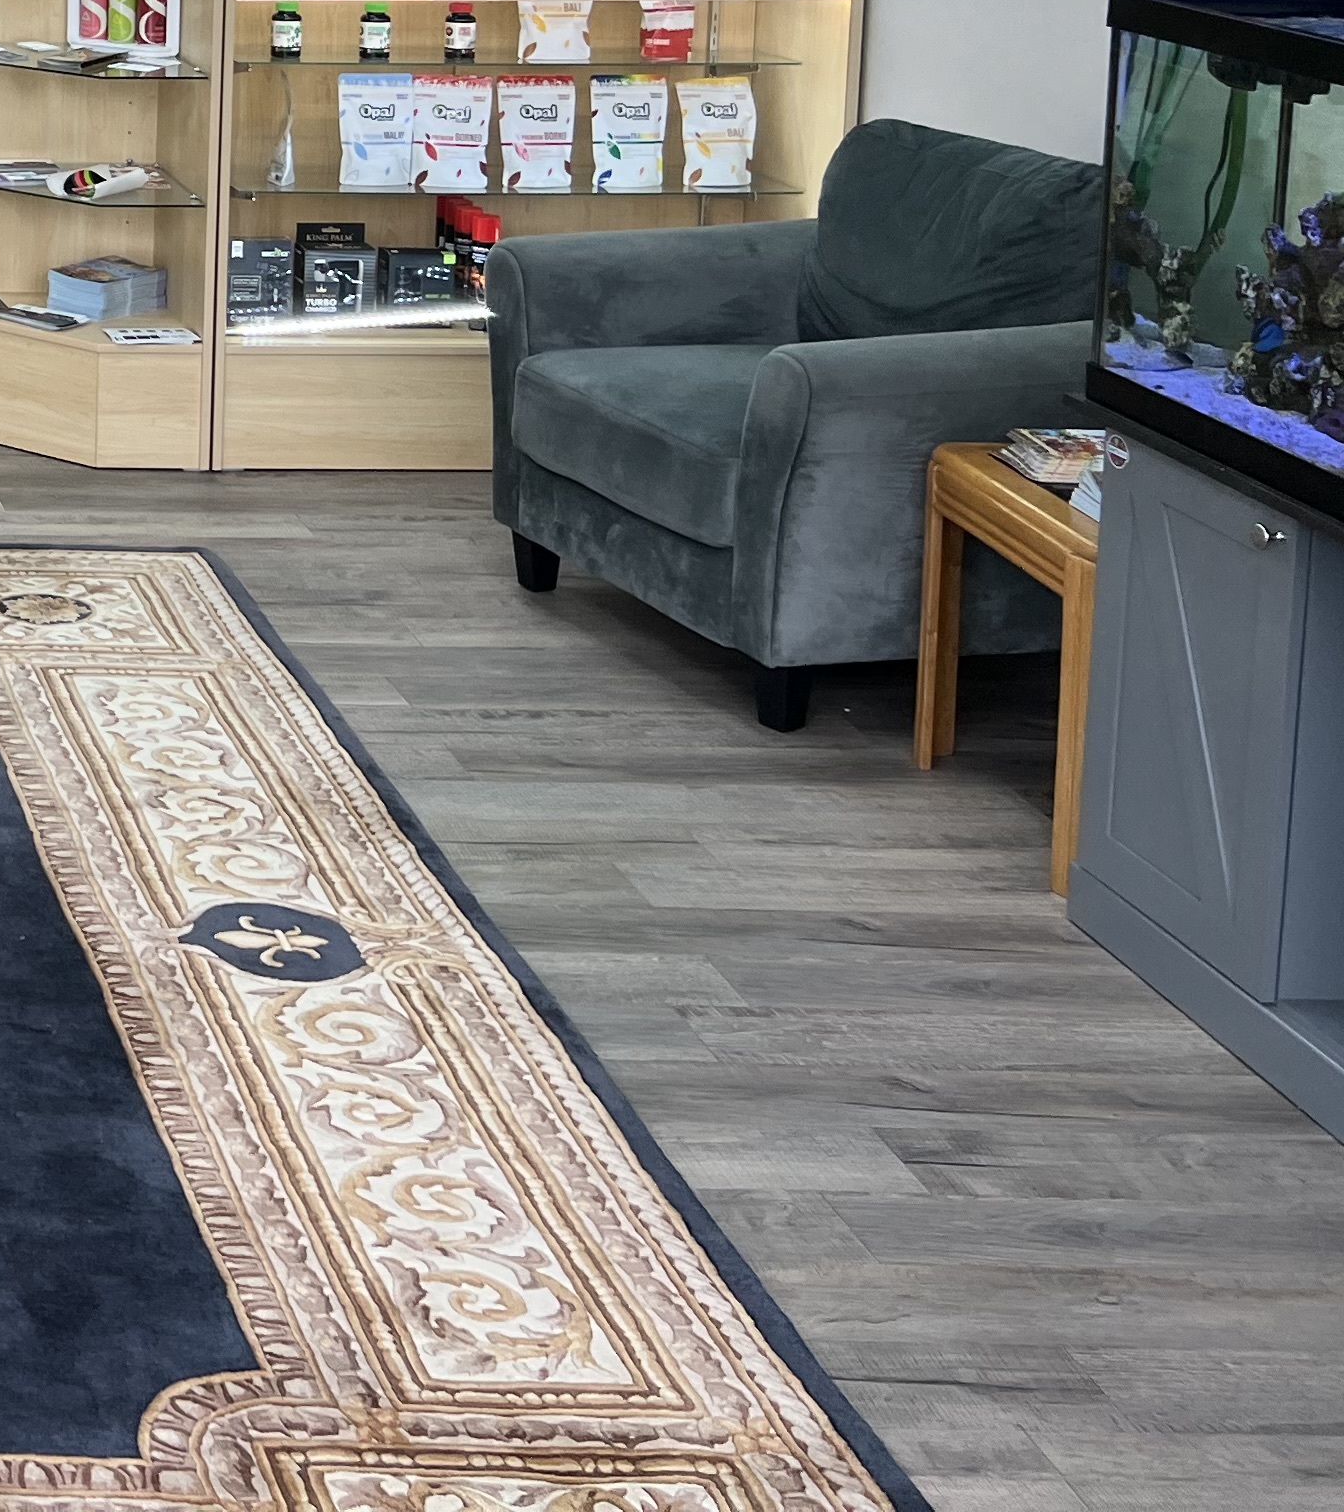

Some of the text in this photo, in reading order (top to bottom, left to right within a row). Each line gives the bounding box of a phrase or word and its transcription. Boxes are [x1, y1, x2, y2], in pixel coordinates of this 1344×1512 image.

[563, 2, 582, 13] BALI
[359, 104, 395, 120] Opal
[432, 104, 471, 121] Opal
[519, 104, 558, 120] Opal
[613, 103, 650, 119] Opal
[701, 103, 738, 119] Opal
[305, 233, 352, 241] KING PALM
[305, 298, 338, 307] TURBO
[230, 315, 245, 324] Cigar
